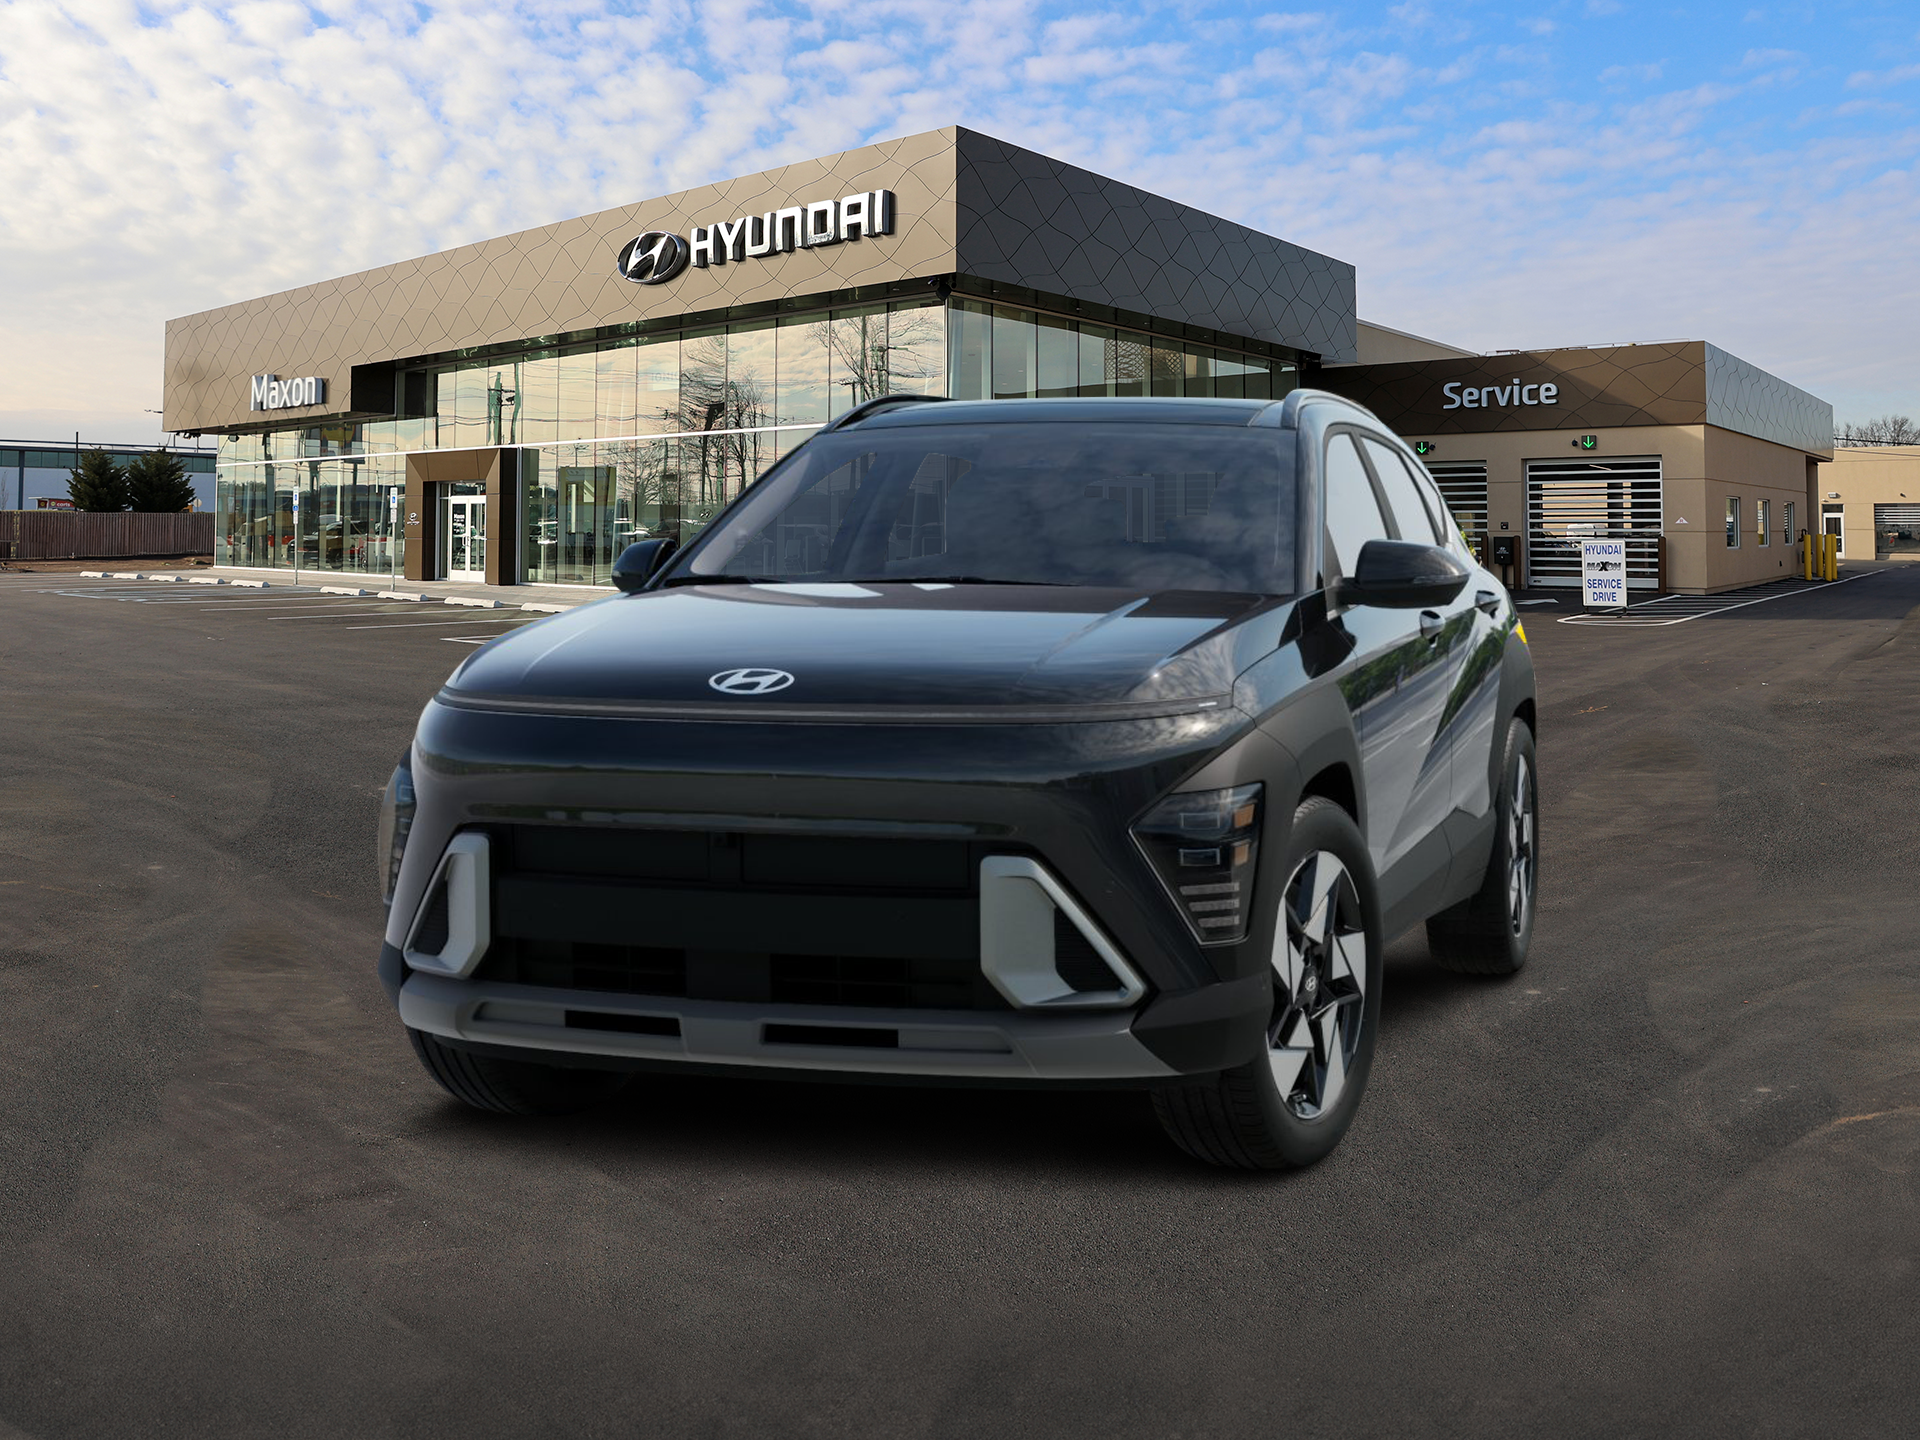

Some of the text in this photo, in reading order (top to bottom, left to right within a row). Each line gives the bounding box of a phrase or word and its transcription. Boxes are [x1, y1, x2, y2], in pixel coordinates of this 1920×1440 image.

[690, 189, 890, 268] HYUNDAI
[250, 374, 320, 411] Maxon
[1443, 378, 1559, 409] Service
[1585, 545, 1622, 555] HYUNDAI
[1587, 561, 1621, 571] MAXON
[1587, 579, 1622, 589] SERVICE
[1593, 592, 1617, 602] DRIVE
